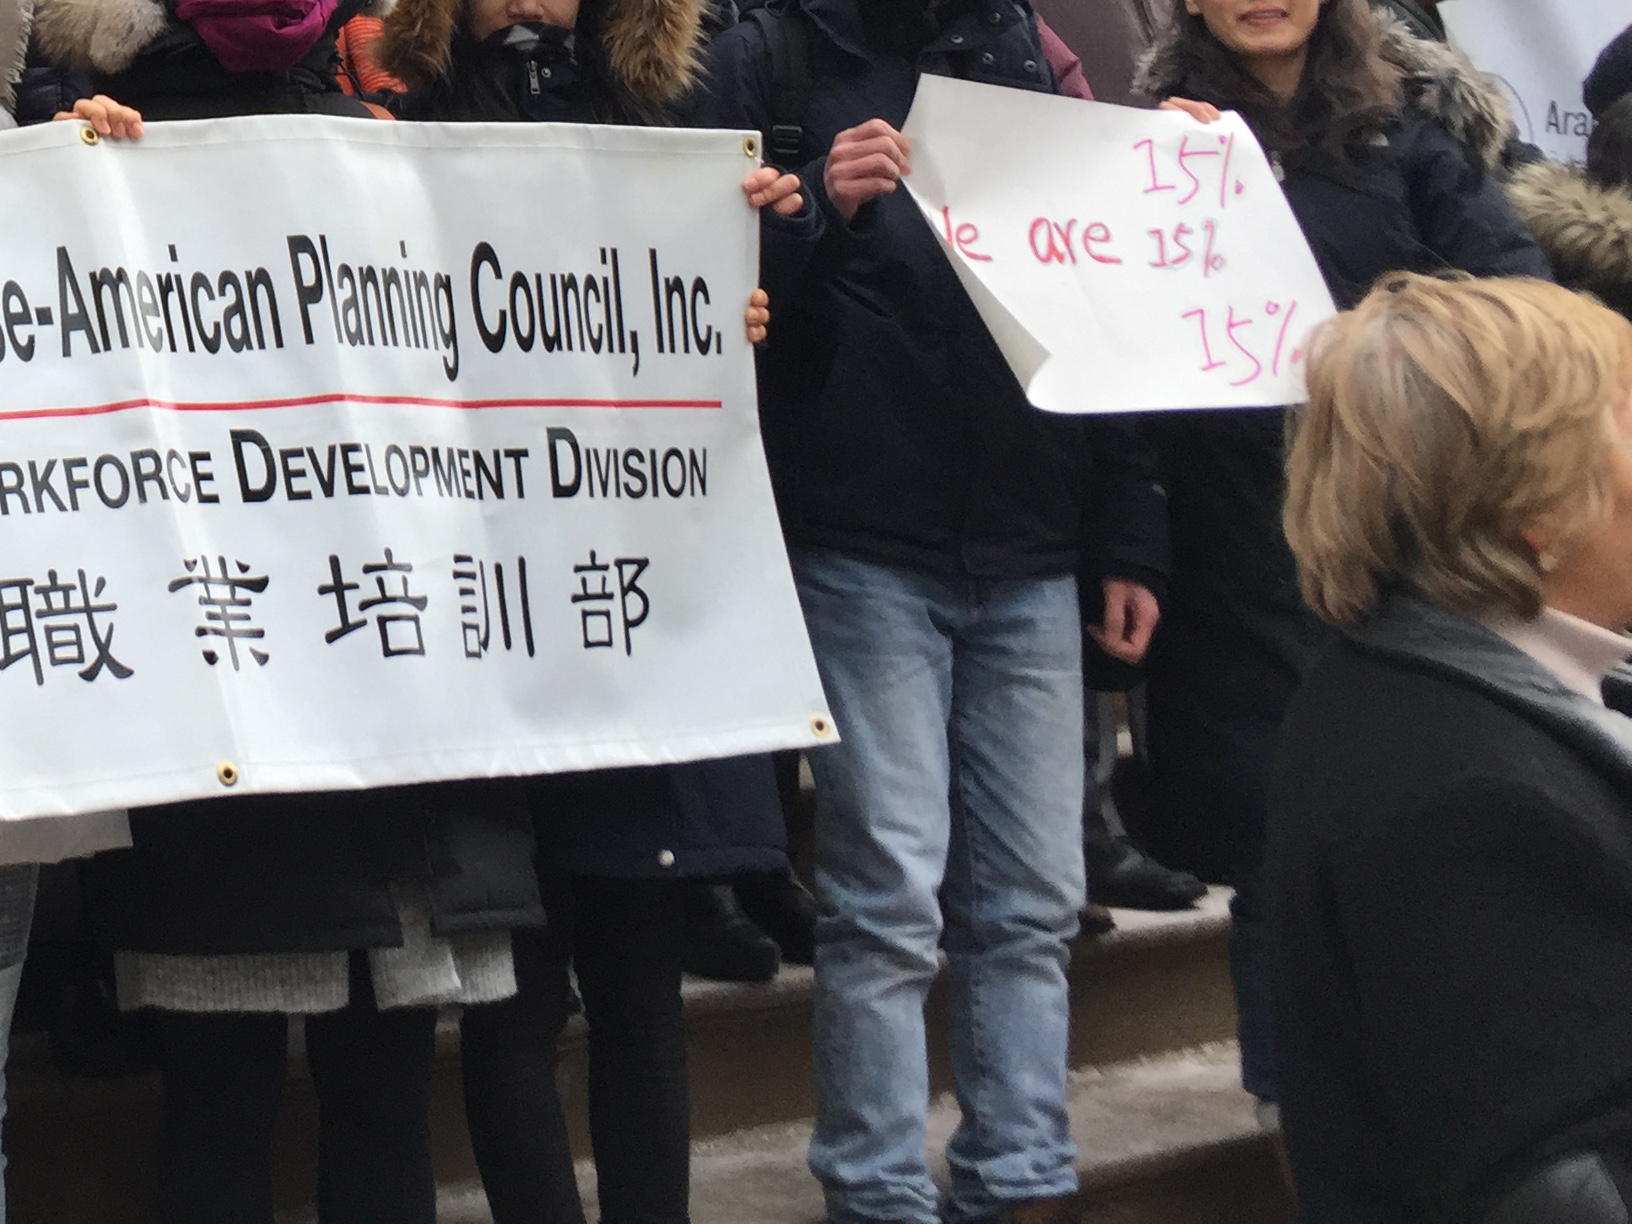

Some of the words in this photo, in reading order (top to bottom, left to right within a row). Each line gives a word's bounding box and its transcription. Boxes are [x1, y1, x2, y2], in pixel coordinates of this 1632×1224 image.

[1545, 99, 1593, 138] Ara
[1133, 131, 1245, 208] 15%
[1028, 216, 1122, 266] are
[1148, 219, 1226, 278] 15%
[285, 233, 460, 382] Planning
[469, 240, 640, 377] Council,
[648, 247, 723, 356] Inc.
[1181, 299, 1303, 388] 15%
[228, 427, 530, 504] DEVELOPMENT
[545, 426, 709, 501] DIVISION
